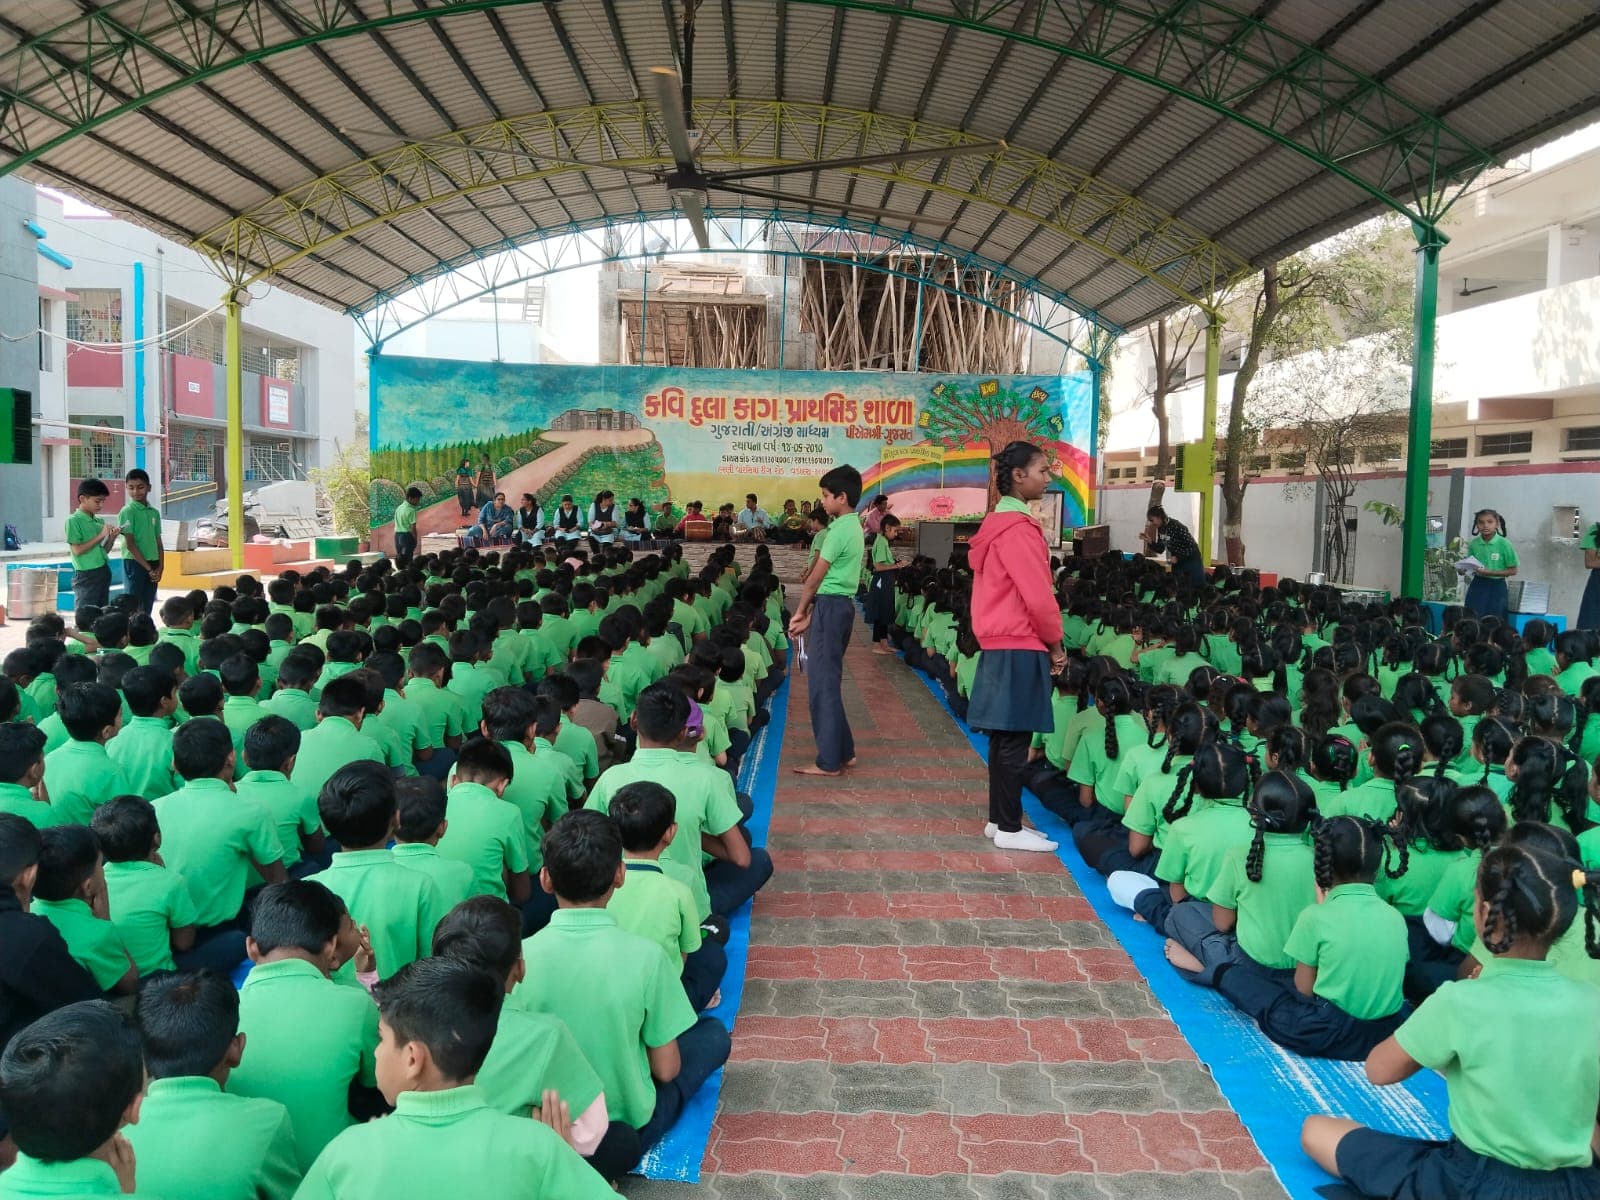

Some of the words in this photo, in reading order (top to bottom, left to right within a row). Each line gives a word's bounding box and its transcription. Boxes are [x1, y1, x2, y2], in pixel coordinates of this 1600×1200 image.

[644, 387, 685, 418] કવિ
[689, 397, 726, 426] દુલા
[733, 398, 778, 421] કાગ
[784, 392, 857, 423] પ્રાથમિક
[863, 400, 913, 425] શાળા
[796, 424, 829, 438] માધ્યમ
[732, 441, 761, 451] સ્થાપના
